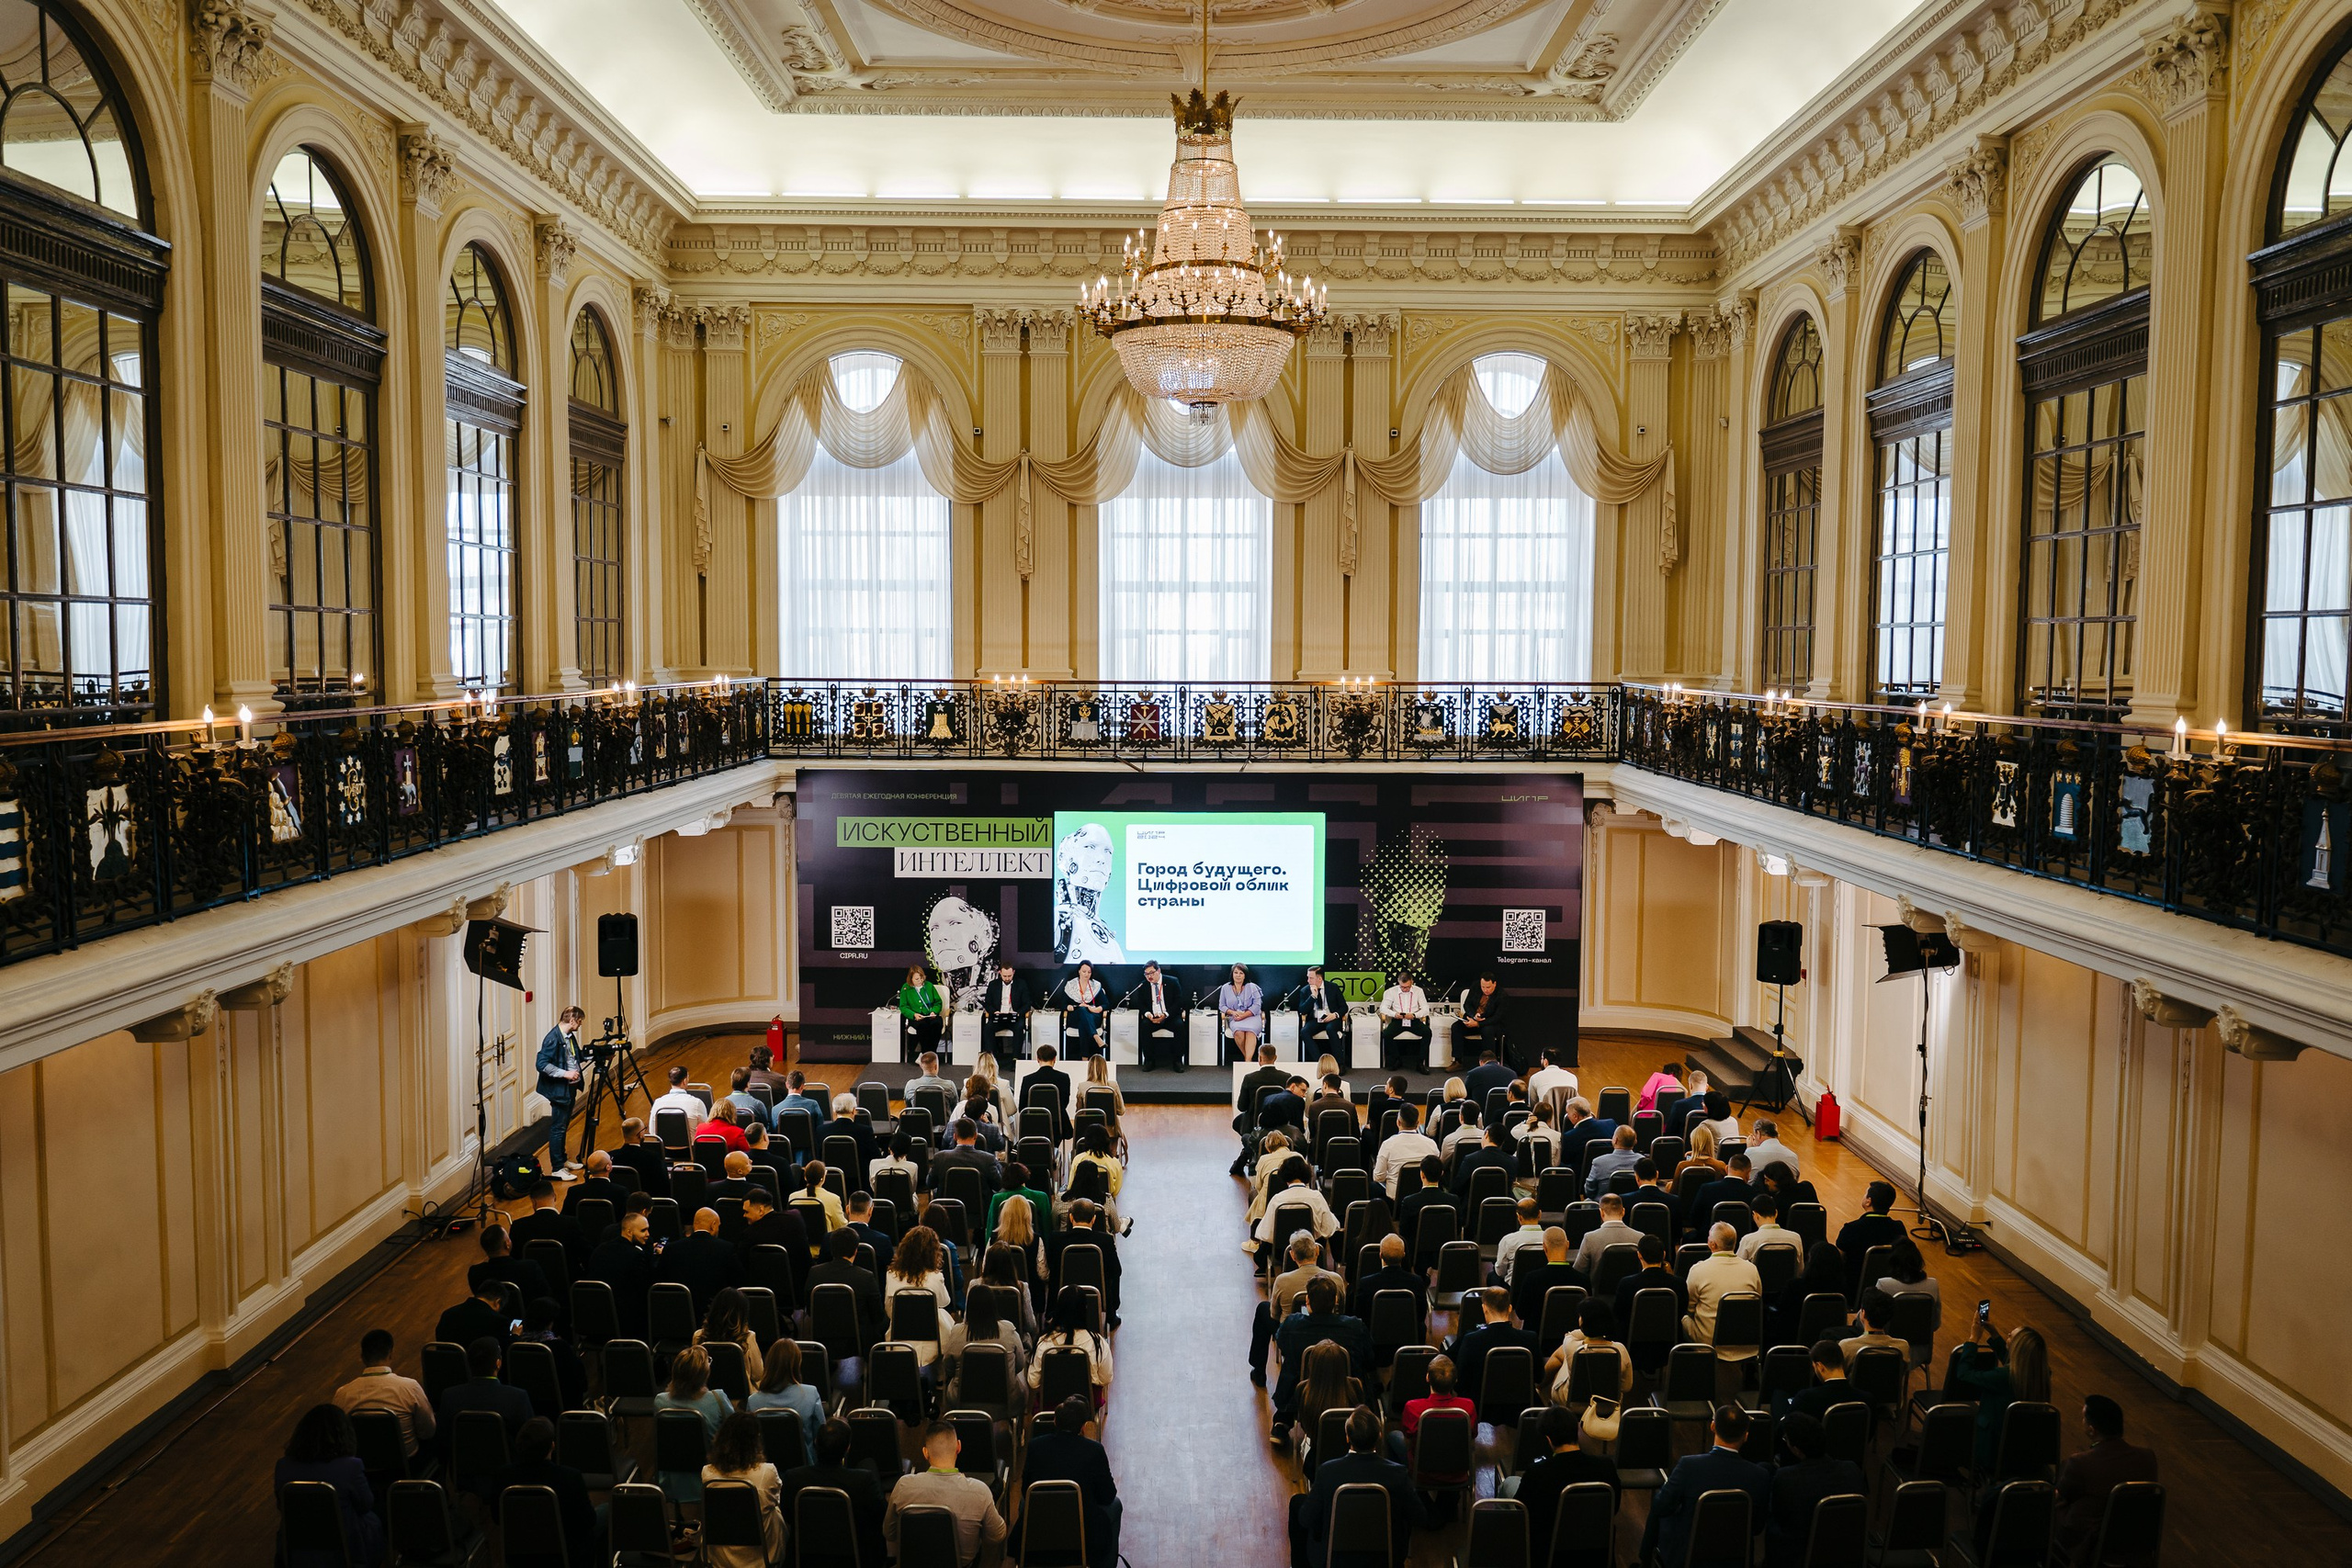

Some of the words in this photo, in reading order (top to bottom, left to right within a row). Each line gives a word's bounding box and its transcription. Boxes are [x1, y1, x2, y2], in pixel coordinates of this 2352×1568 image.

[906, 793, 957, 801] КОНФЕРЕНЦИЯ
[842, 817, 1049, 842] ИСКУСТВЕННЫЙ
[899, 851, 1050, 873] ИНТЕЛЛЕКТ
[1137, 862, 1188, 878] Город
[1193, 861, 1287, 878] будущего.
[1137, 877, 1231, 894] Цифровой
[1236, 877, 1289, 892] облик
[1137, 896, 1205, 909] страны
[1330, 977, 1377, 997] ЭТО
[832, 1032, 865, 1041] НИЖНИЙ
